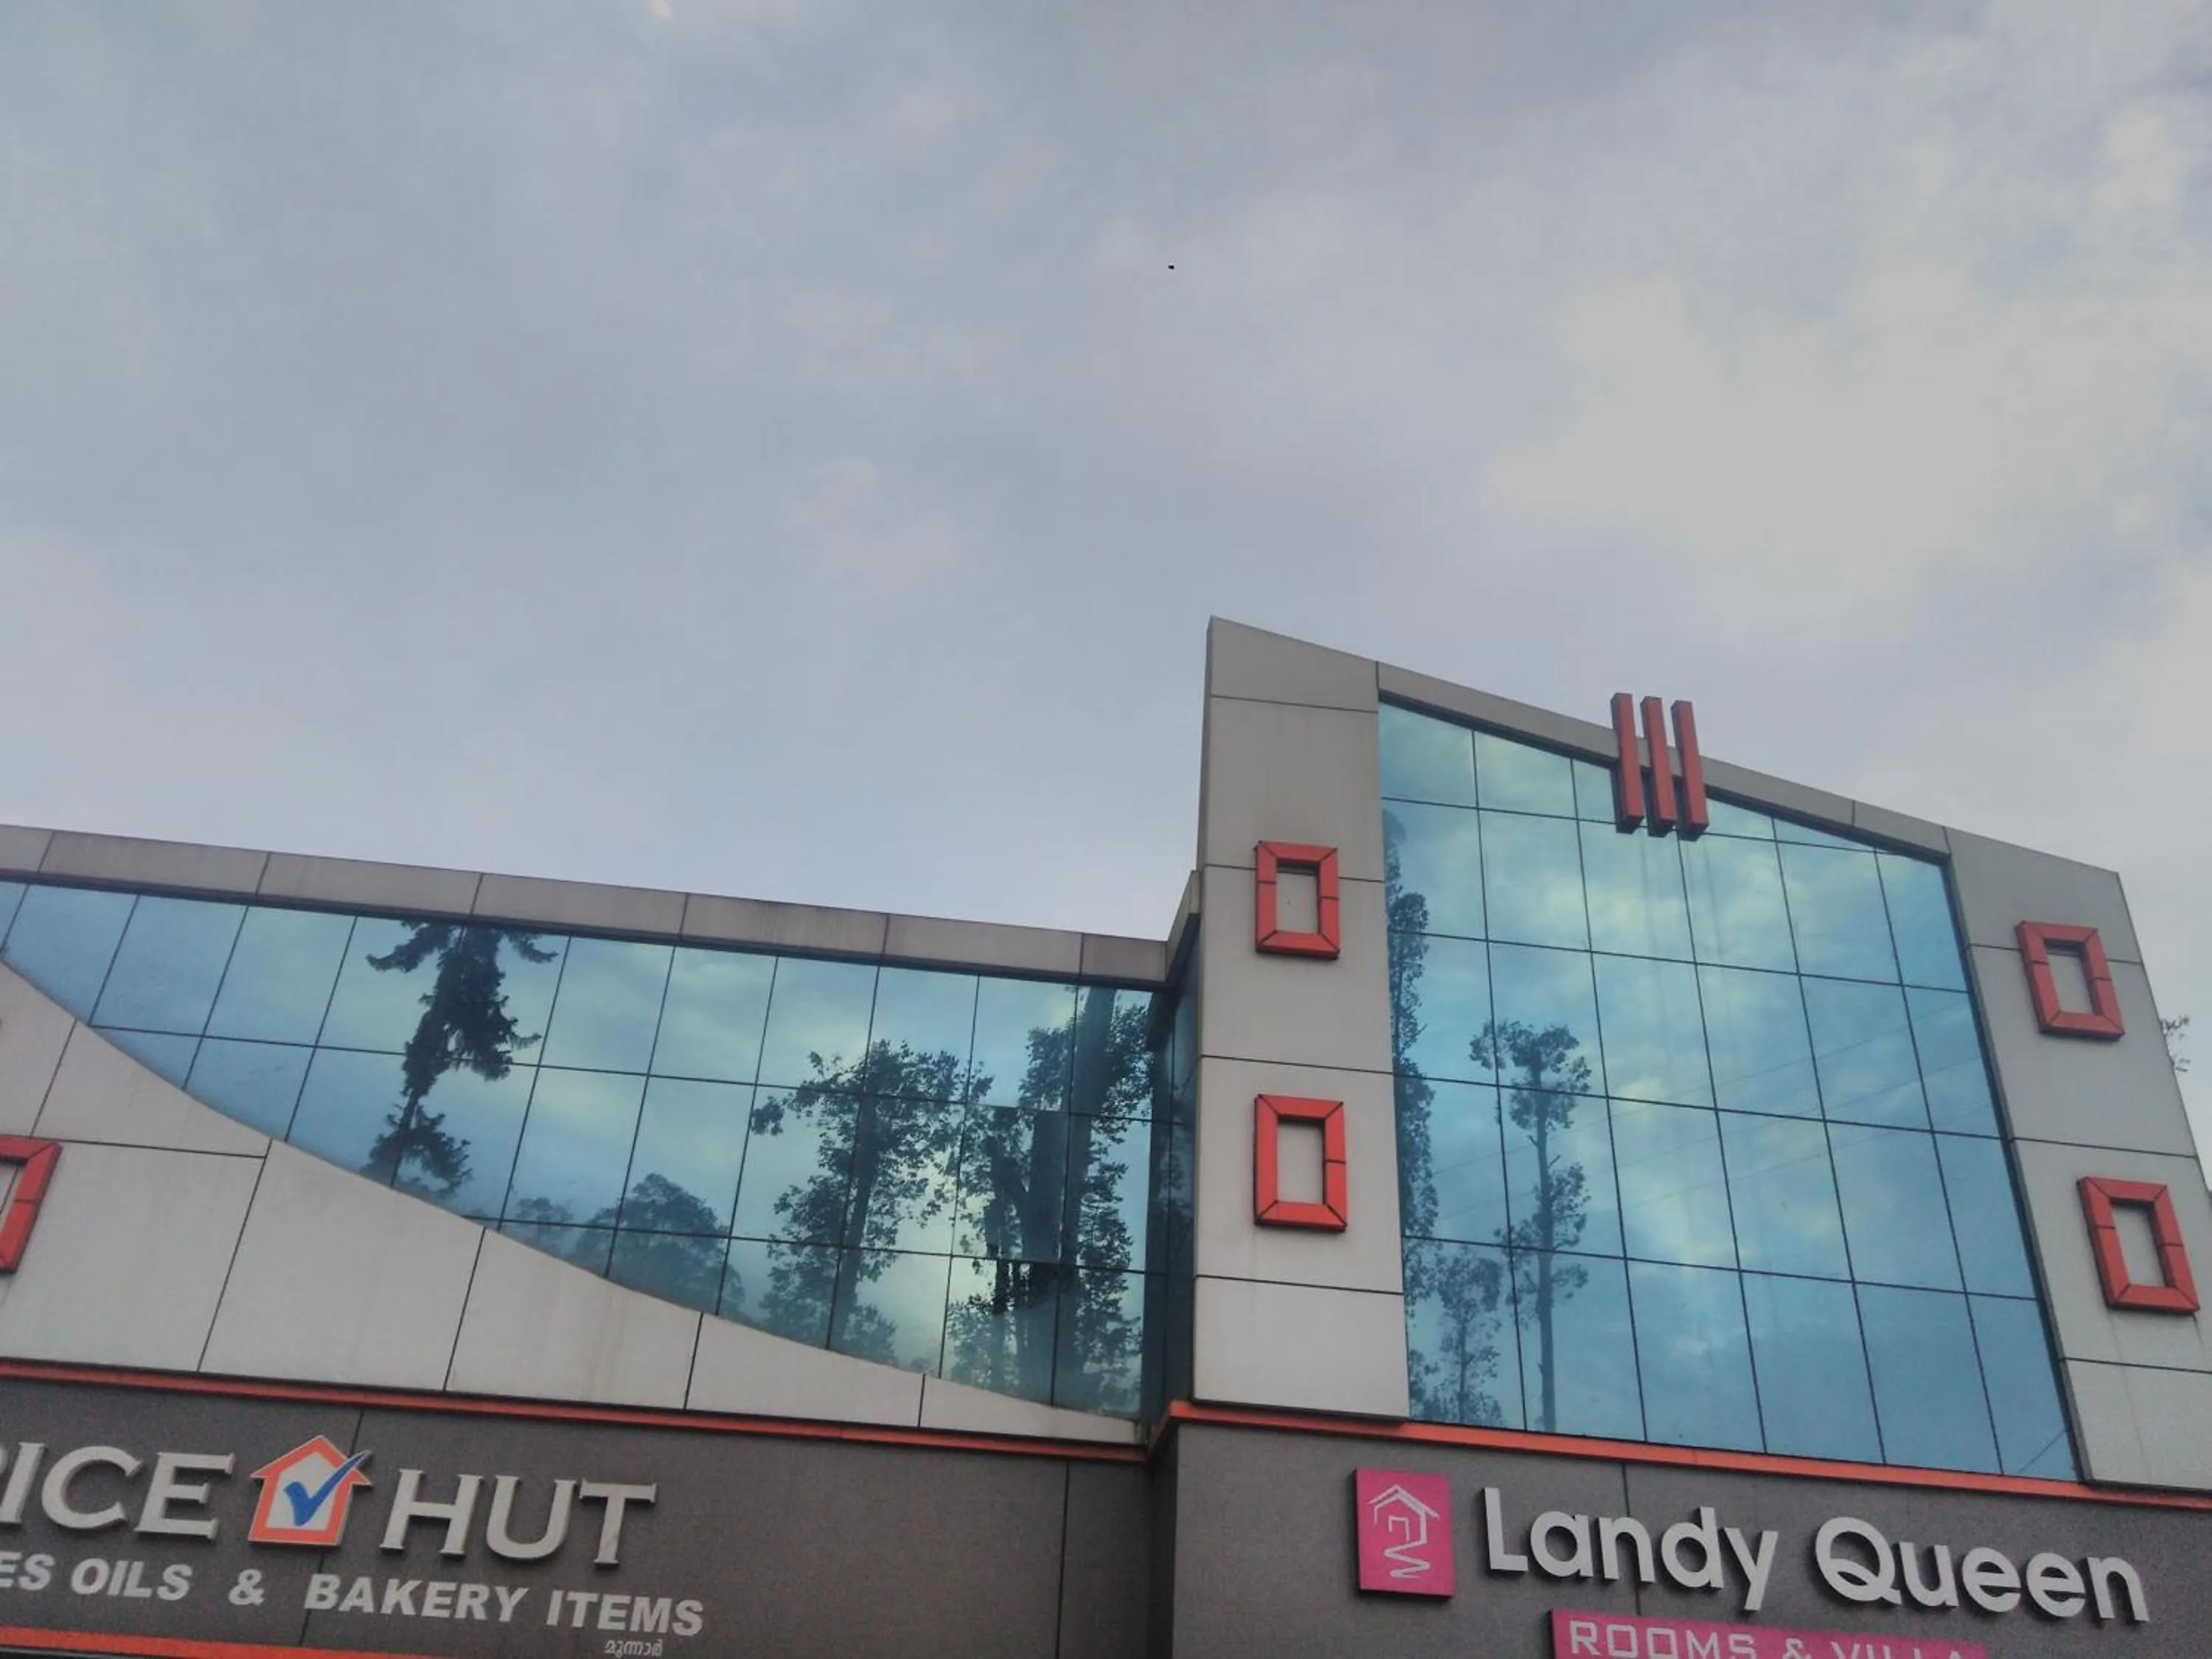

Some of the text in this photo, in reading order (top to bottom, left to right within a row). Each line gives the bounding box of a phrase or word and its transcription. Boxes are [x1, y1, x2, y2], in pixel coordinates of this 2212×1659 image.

[0, 1441, 658, 1565] ICE HUT
[72, 1558, 193, 1601] OILS
[229, 1569, 265, 1607] &
[304, 1573, 529, 1623] BAKERY
[546, 1590, 704, 1636] ITEMS
[1484, 1487, 2149, 1622] Landy Queen
[1570, 1621, 1756, 1659] ROOMS
[1783, 1637, 1813, 1659] &
